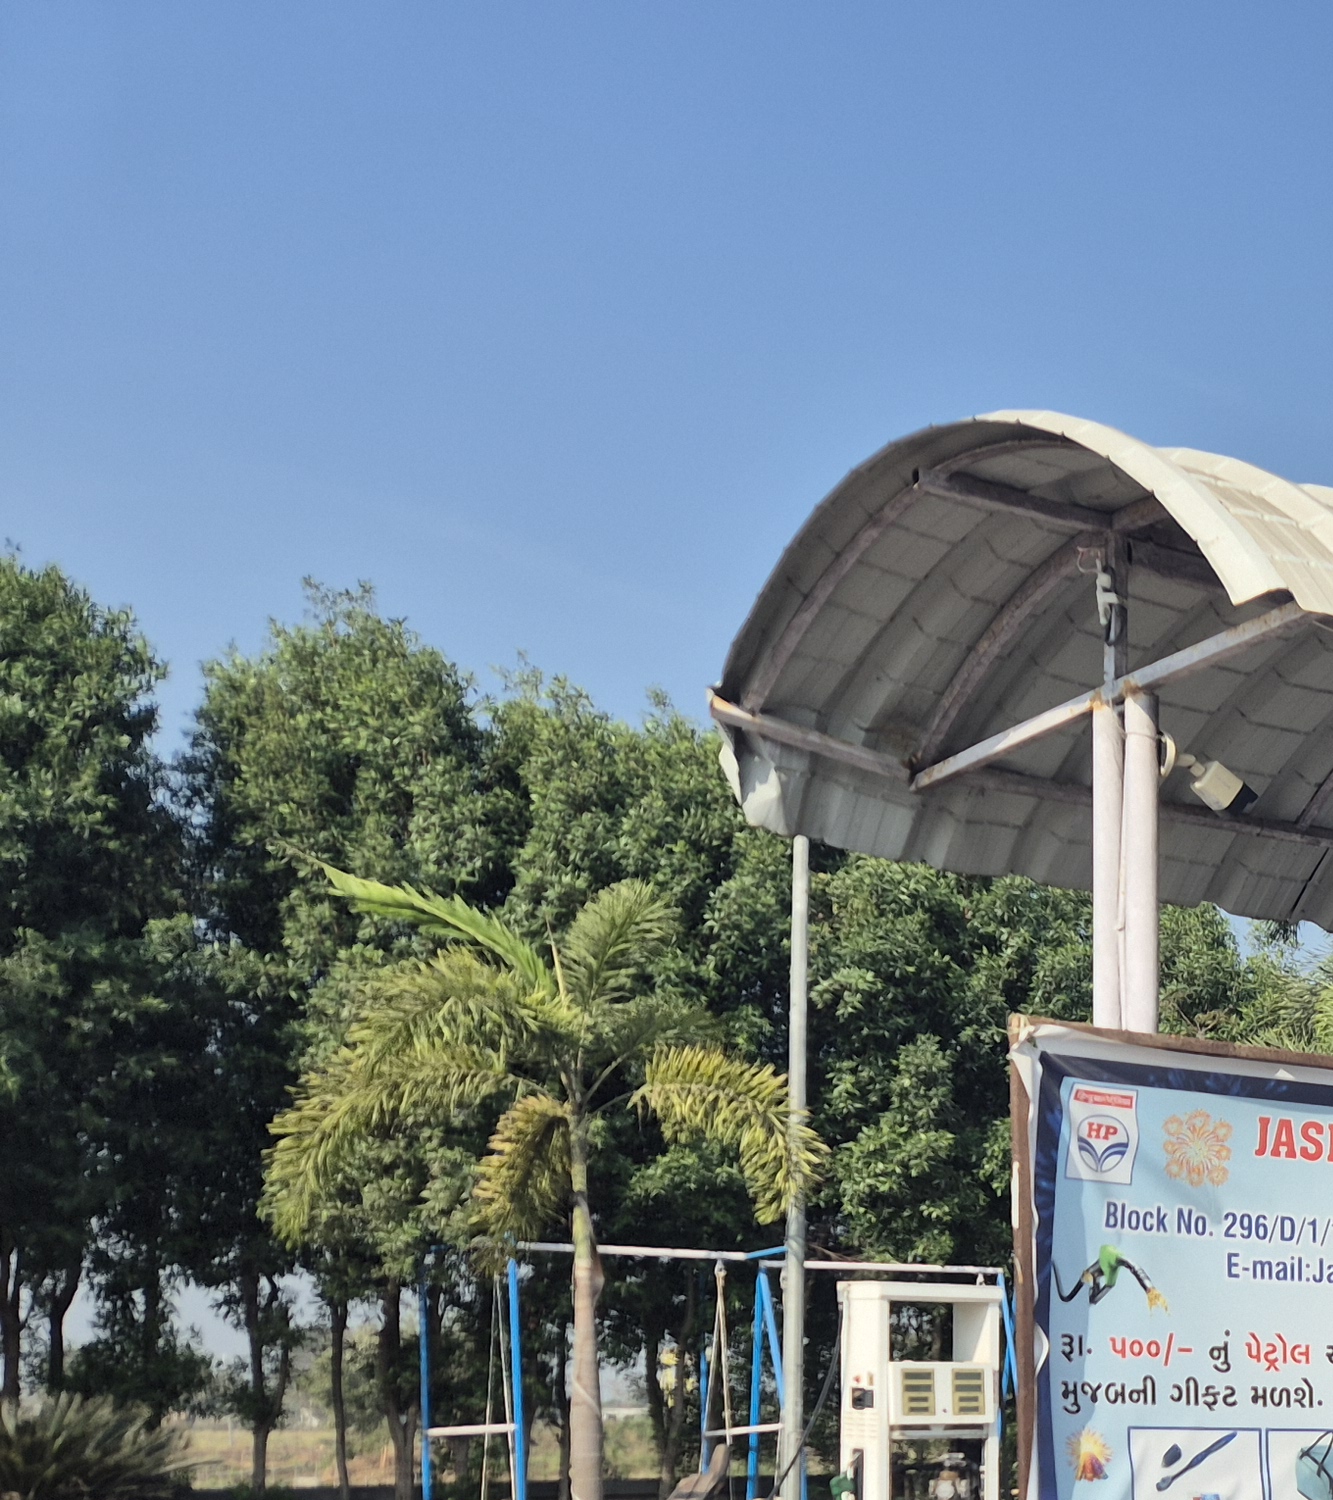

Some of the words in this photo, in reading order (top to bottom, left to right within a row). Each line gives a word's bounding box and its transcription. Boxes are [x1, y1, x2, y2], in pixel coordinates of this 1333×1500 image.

[1087, 1122, 1118, 1140] HP
[1105, 1200, 1168, 1233] Block
[1176, 1207, 1214, 1237] No.
[1208, 1329, 1231, 1373] નું
[1245, 1331, 1312, 1373] પેટ્રોલ
[1061, 1374, 1157, 1415] મુજબની
